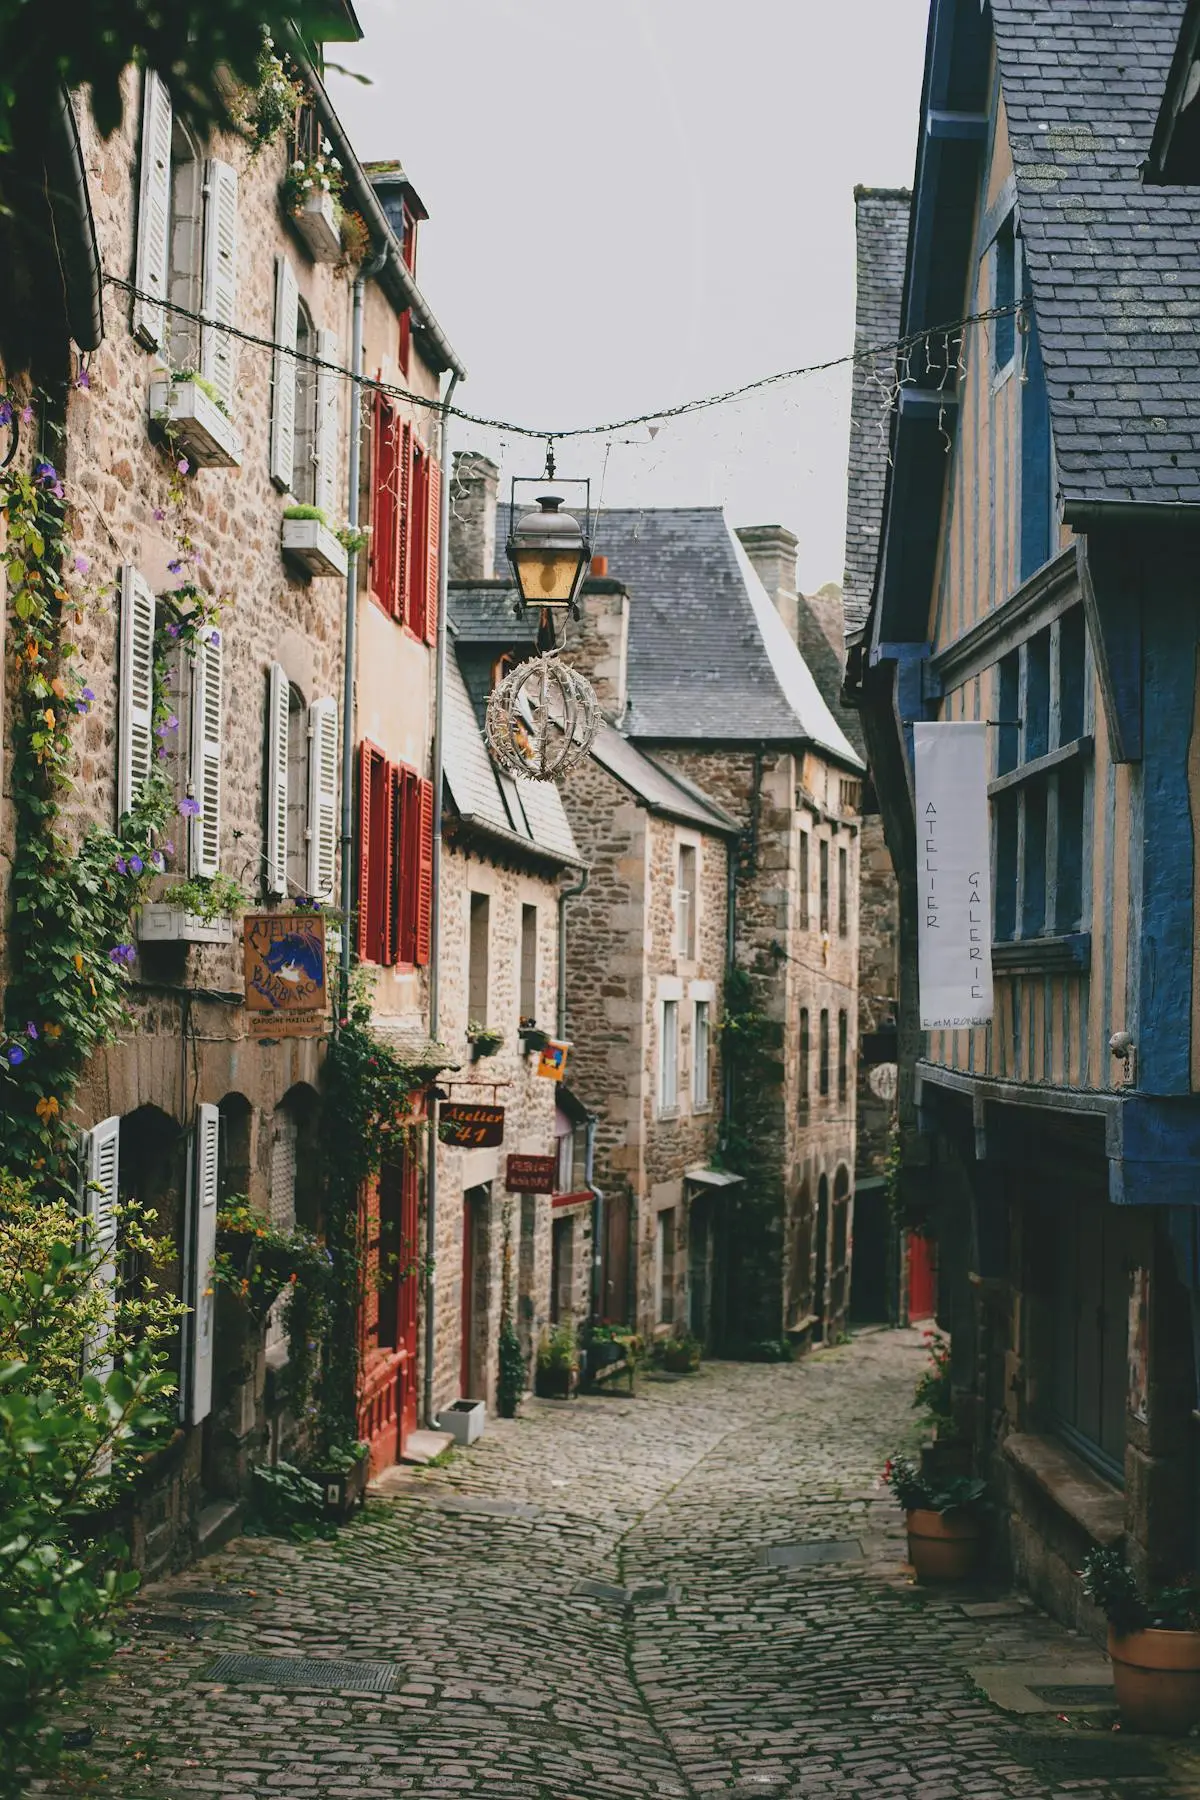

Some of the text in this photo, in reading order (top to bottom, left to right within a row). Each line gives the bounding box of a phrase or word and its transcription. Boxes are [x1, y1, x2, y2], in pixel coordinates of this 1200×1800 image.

[925, 801, 939, 928] ATELIER
[251, 920, 313, 937] ATELIER
[968, 872, 983, 998] GALERIE
[252, 963, 316, 1000] BARBARO
[444, 1107, 503, 1123] Atelier
[455, 1126, 487, 1142] 41
